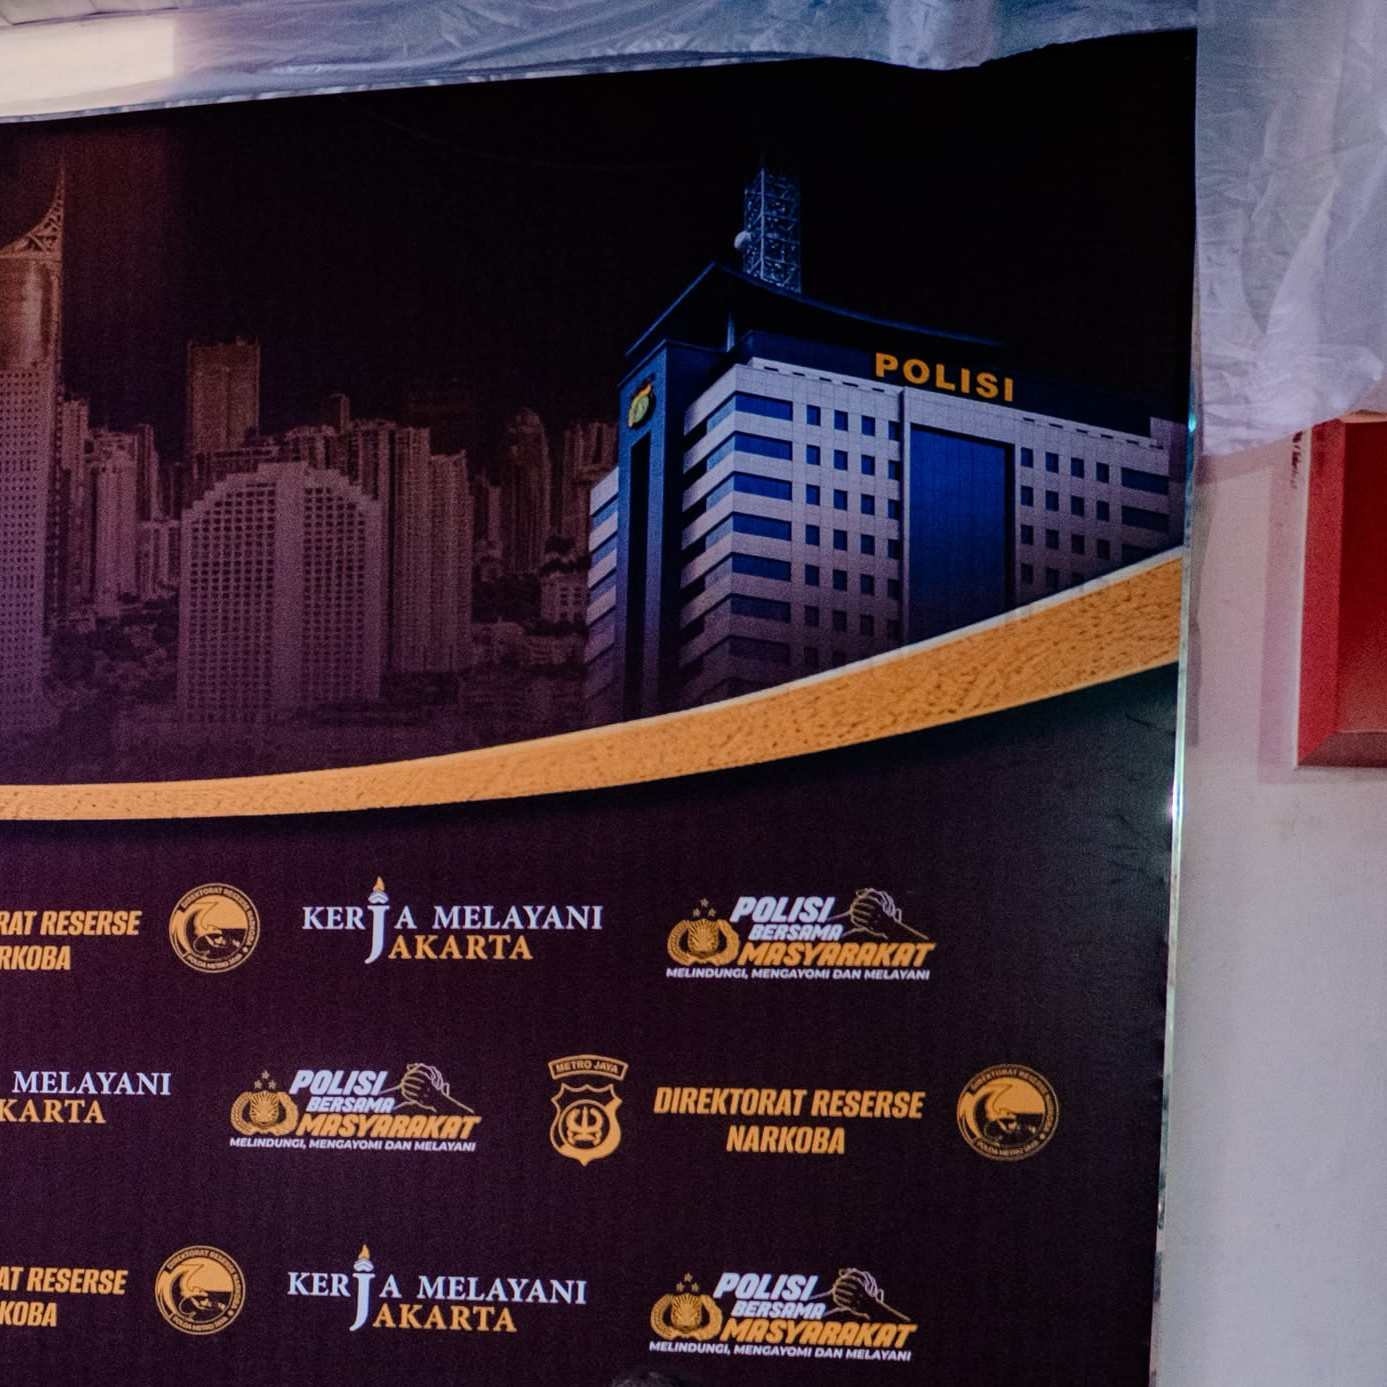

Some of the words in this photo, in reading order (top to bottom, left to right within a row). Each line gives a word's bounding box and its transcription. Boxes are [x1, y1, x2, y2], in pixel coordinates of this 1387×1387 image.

[876, 352, 1013, 401] POLISI
[432, 905, 603, 929] MELAYANI
[729, 896, 834, 923] POLISI
[40, 911, 142, 935] RESERSE
[748, 923, 842, 941] BERSAMA
[738, 941, 936, 967] MASYARAKAT
[666, 968, 748, 979] MELINDUNGI,
[751, 968, 830, 979] MENGAYOMI
[832, 969, 862, 979] DAN
[864, 969, 930, 980] MELAYANI
[556, 1059, 589, 1074] METRO
[592, 1060, 619, 1075] JAYA
[12, 1071, 171, 1095] MELAYANI
[291, 1069, 388, 1095] POLISI
[306, 1097, 396, 1113] BERSAMA
[654, 1087, 807, 1116] DIREKTORAT
[811, 1090, 925, 1118] RESERSE
[296, 1114, 481, 1139] MASYARAKAT
[726, 1125, 844, 1154] NARKOBA
[27, 1267, 128, 1294] RESERSE
[417, 1276, 587, 1304] MELAYANI
[713, 1272, 818, 1301] POLISI
[732, 1299, 825, 1320] BERSAMA
[720, 1318, 917, 1348] MASYARAKAT
